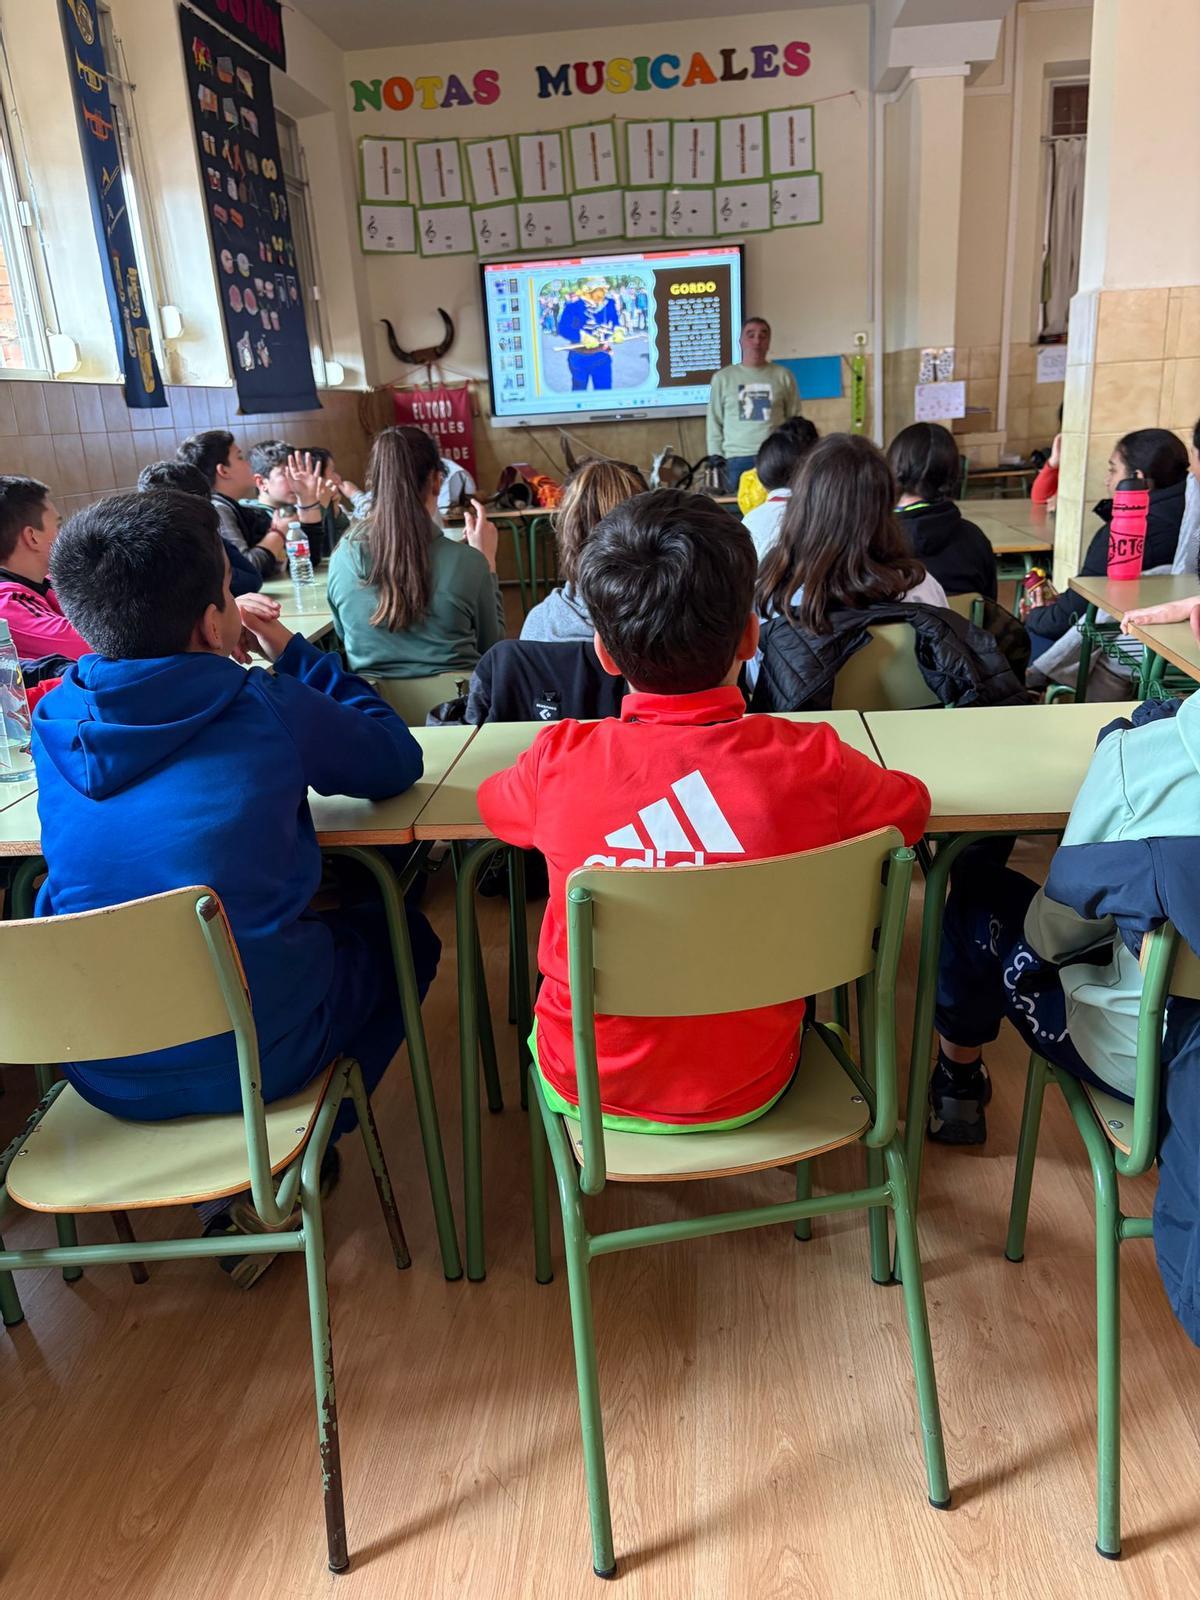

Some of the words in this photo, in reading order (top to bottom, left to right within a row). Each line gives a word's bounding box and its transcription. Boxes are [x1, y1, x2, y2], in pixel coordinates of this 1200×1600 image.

[350, 69, 501, 112] NOTAS
[536, 41, 812, 98] MUSICALES
[670, 281, 717, 295] GORDO
